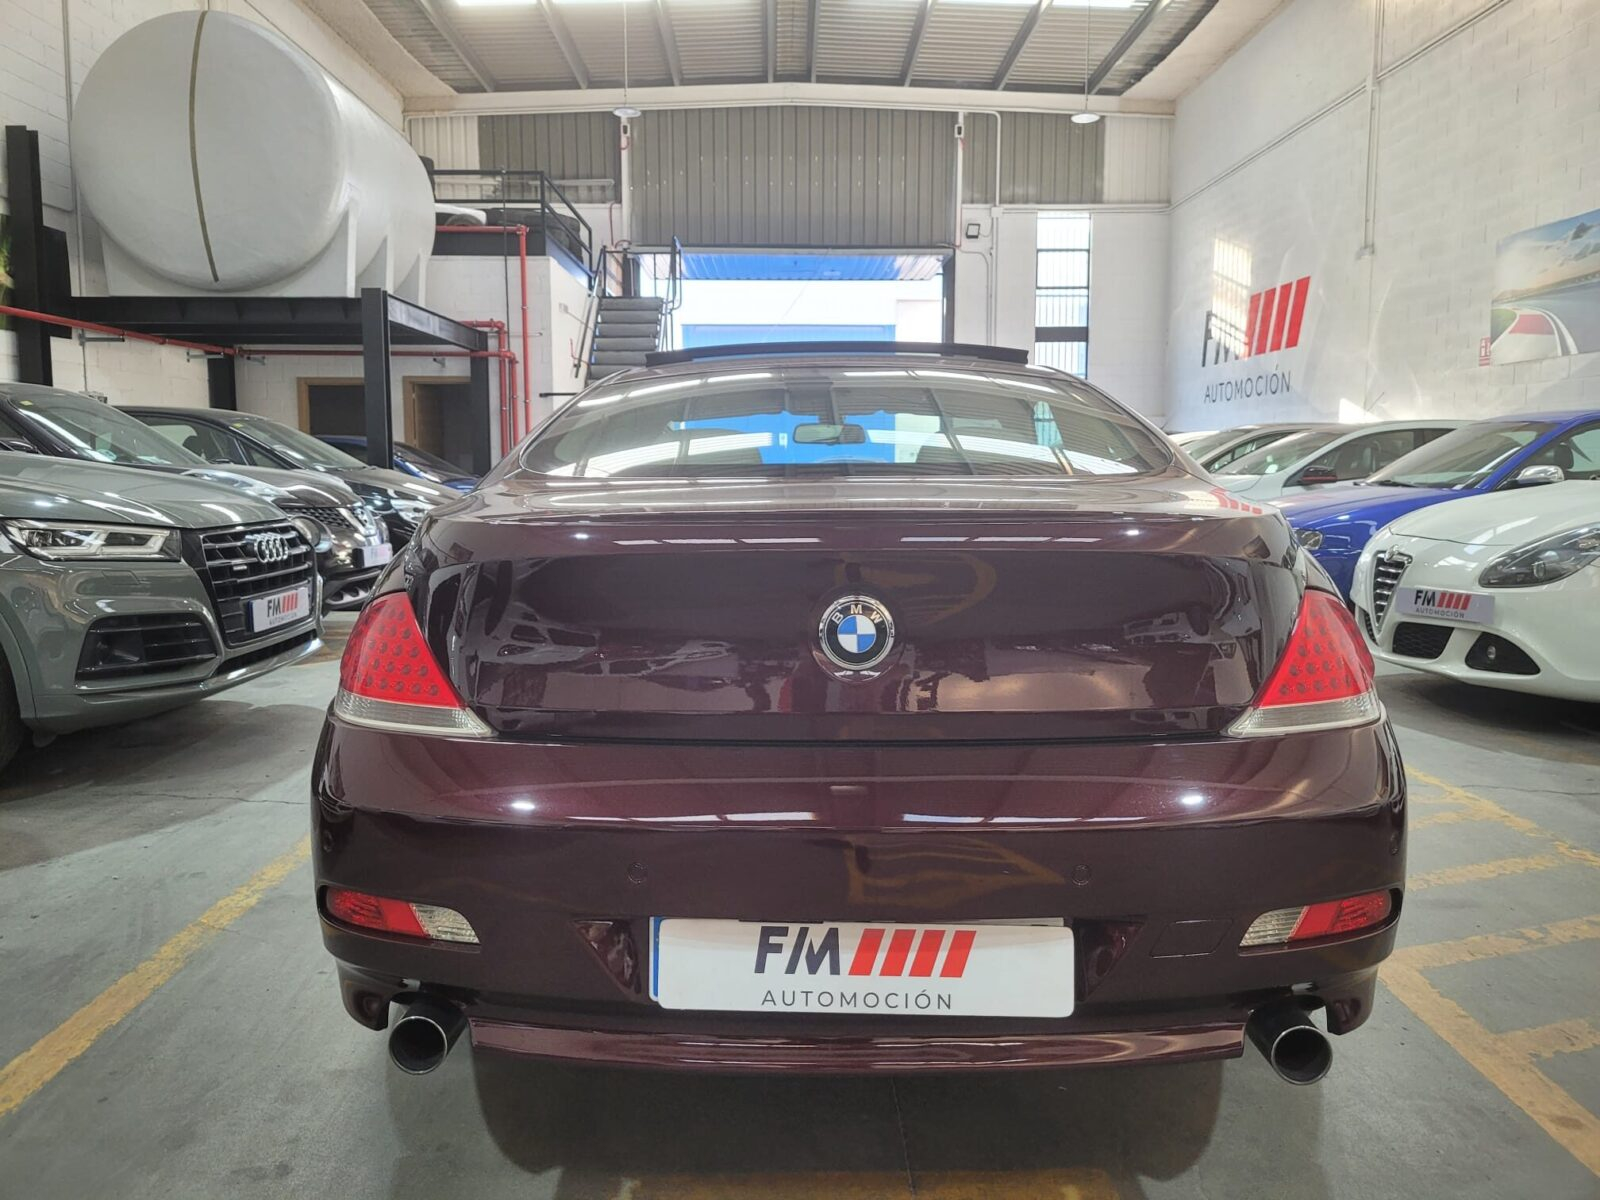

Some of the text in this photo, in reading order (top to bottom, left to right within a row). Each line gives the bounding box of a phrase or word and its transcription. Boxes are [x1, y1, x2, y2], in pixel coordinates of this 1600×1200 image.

[1204, 363, 1291, 404] AUTOMOCIÓN
[267, 596, 281, 618] FM
[1414, 589, 1436, 607] FM
[831, 603, 884, 625] BMW
[754, 925, 841, 976] FM
[761, 989, 952, 1011] AUTOMOCIÓN
